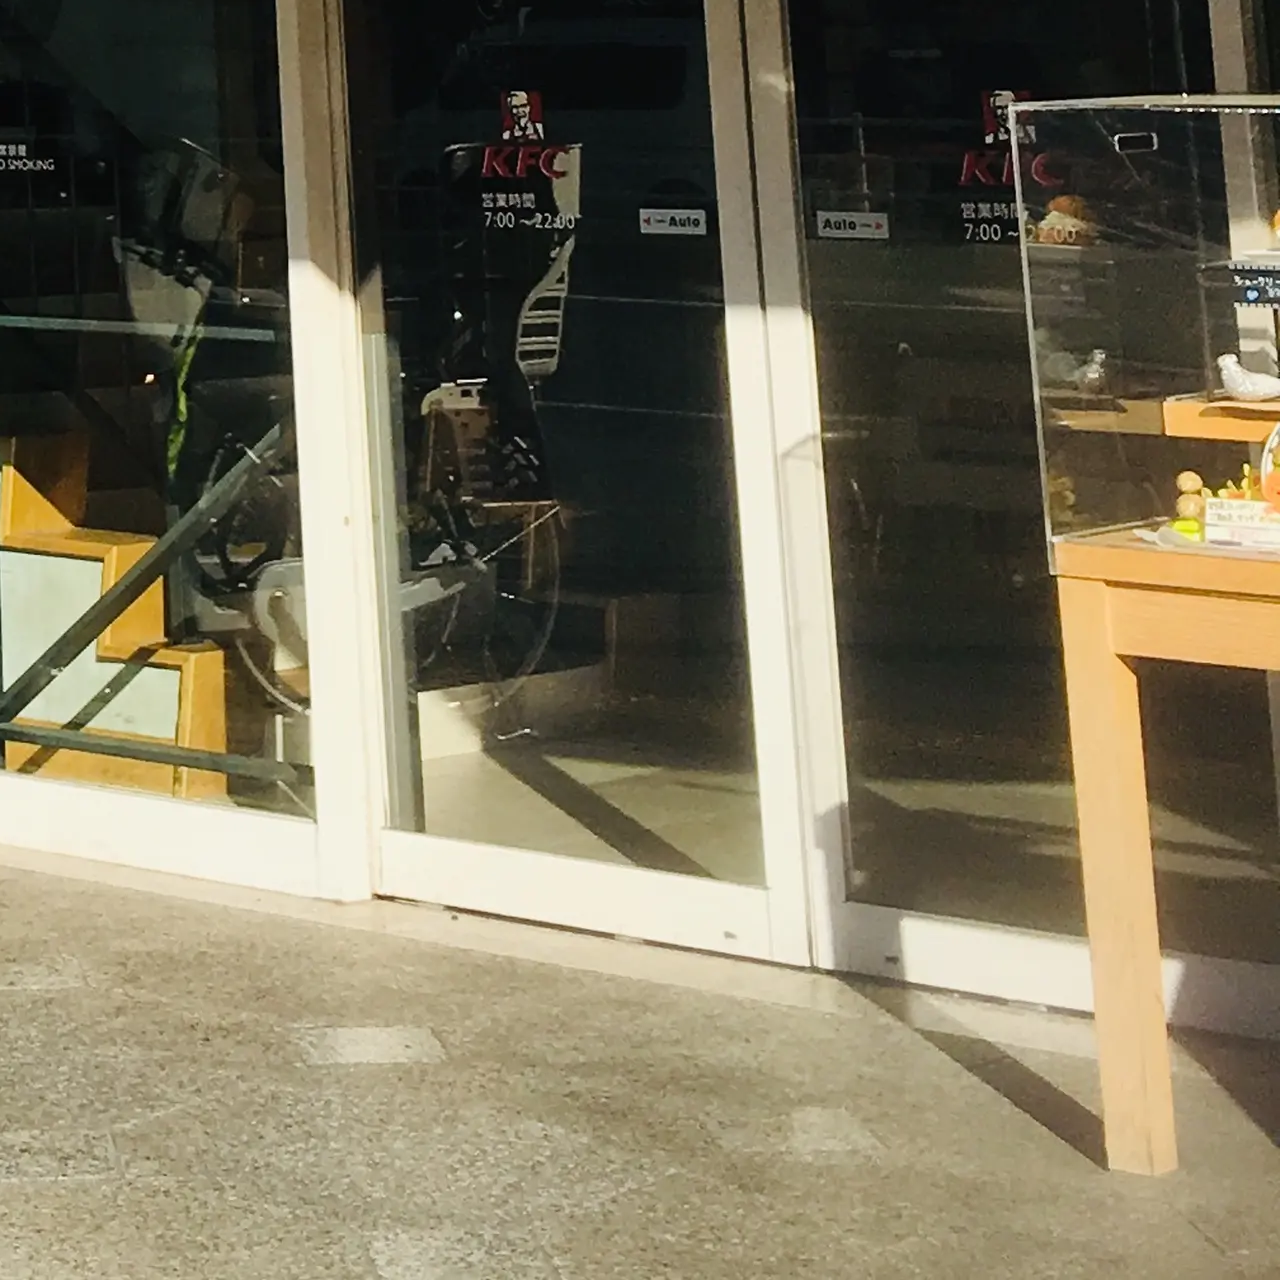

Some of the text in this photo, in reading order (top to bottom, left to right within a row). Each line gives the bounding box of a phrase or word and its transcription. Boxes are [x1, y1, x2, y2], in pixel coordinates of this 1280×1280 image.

[7, 158, 55, 171] SMOKING
[481, 145, 571, 180] KFC
[481, 193, 536, 209] 営業時間
[483, 211, 516, 229] 7:00
[668, 215, 701, 229] Auto
[822, 217, 857, 232] Auto
[964, 223, 1002, 241] 7:00
